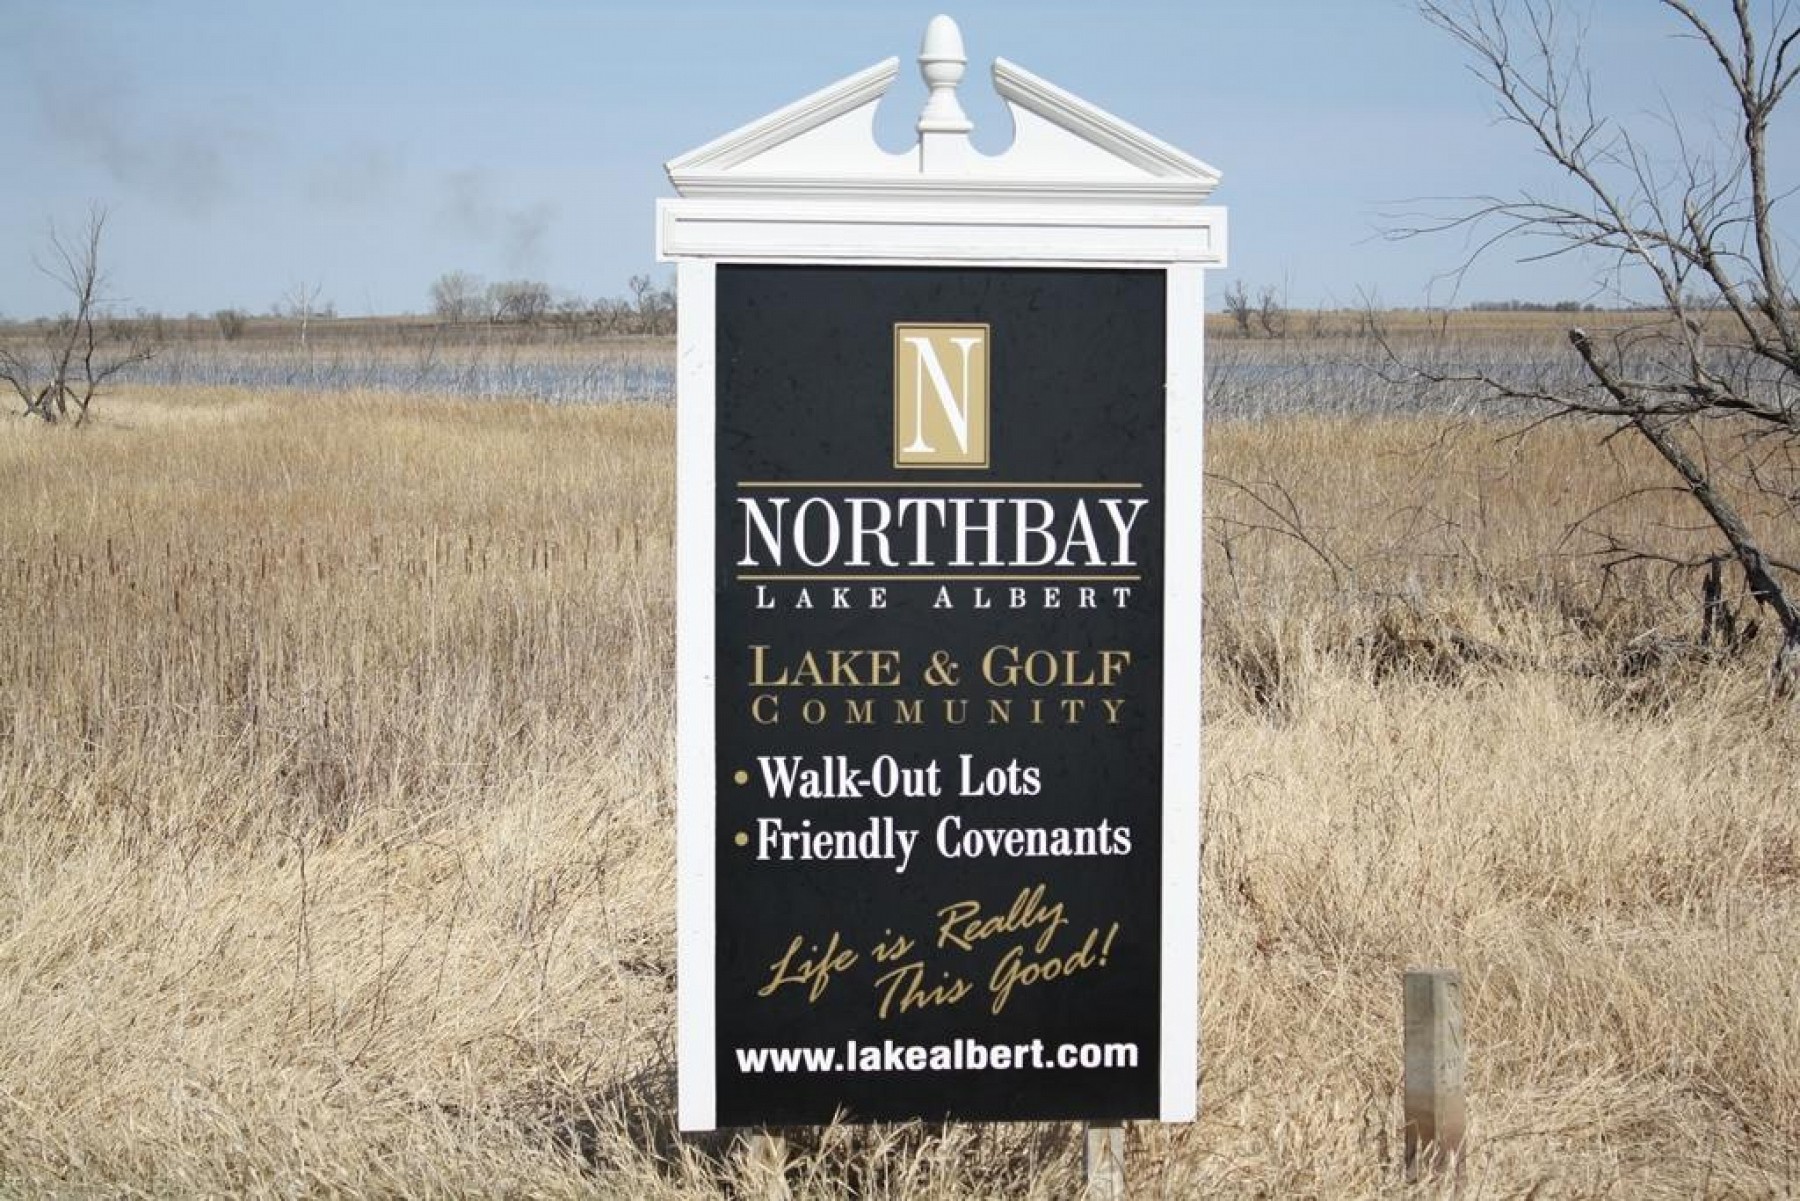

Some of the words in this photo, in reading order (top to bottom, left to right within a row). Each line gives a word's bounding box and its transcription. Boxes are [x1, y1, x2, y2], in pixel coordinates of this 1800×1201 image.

[903, 336, 982, 455] N
[737, 496, 1149, 567] NORTHBAY
[756, 585, 887, 609] LAKE
[933, 585, 1131, 609] ALBERT
[749, 645, 901, 686] LAKE
[924, 650, 959, 687] &
[981, 645, 1130, 686] GOLF
[751, 695, 1125, 724] COMMUNITY
[757, 755, 941, 799] Walk-Out
[959, 754, 1041, 797] Lots
[756, 816, 919, 873] Friendly
[936, 815, 1131, 858] Covenants
[758, 932, 858, 1003] Life
[871, 929, 915, 963] is
[936, 883, 1070, 954] Really
[874, 961, 972, 1019] This
[989, 922, 1119, 1015] Good!
[736, 1039, 1139, 1073] www.lakealbert.com
